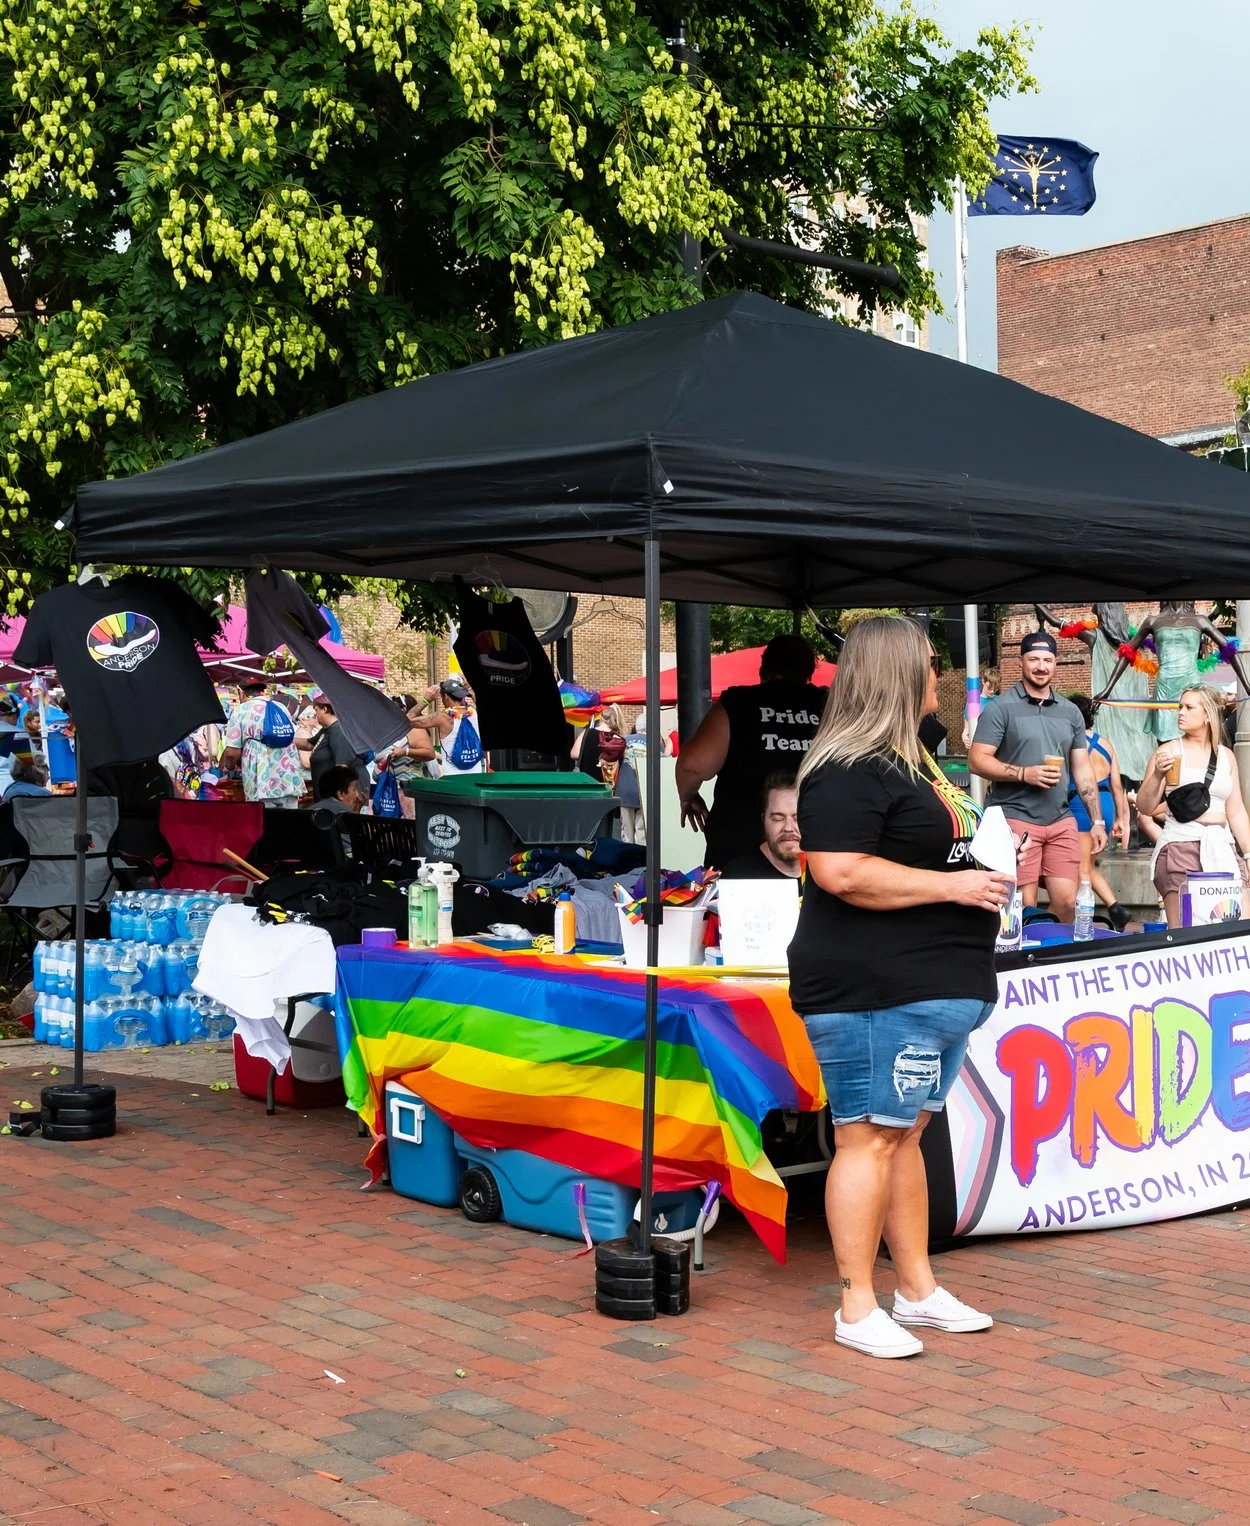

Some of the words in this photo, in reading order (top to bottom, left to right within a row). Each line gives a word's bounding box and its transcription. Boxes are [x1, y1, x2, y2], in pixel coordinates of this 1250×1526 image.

[103, 643, 155, 667] ANDERSON
[118, 652, 144, 669] PRIDE
[490, 675, 516, 685] PRIDE
[759, 707, 820, 726] Pride
[997, 974, 1060, 1009] AINT
[1066, 966, 1114, 999] THE
[1115, 955, 1192, 988] TOWN
[1192, 945, 1250, 978] WITH
[1016, 1170, 1197, 1232] ANDERSON,
[1197, 1160, 1230, 1188] IN
